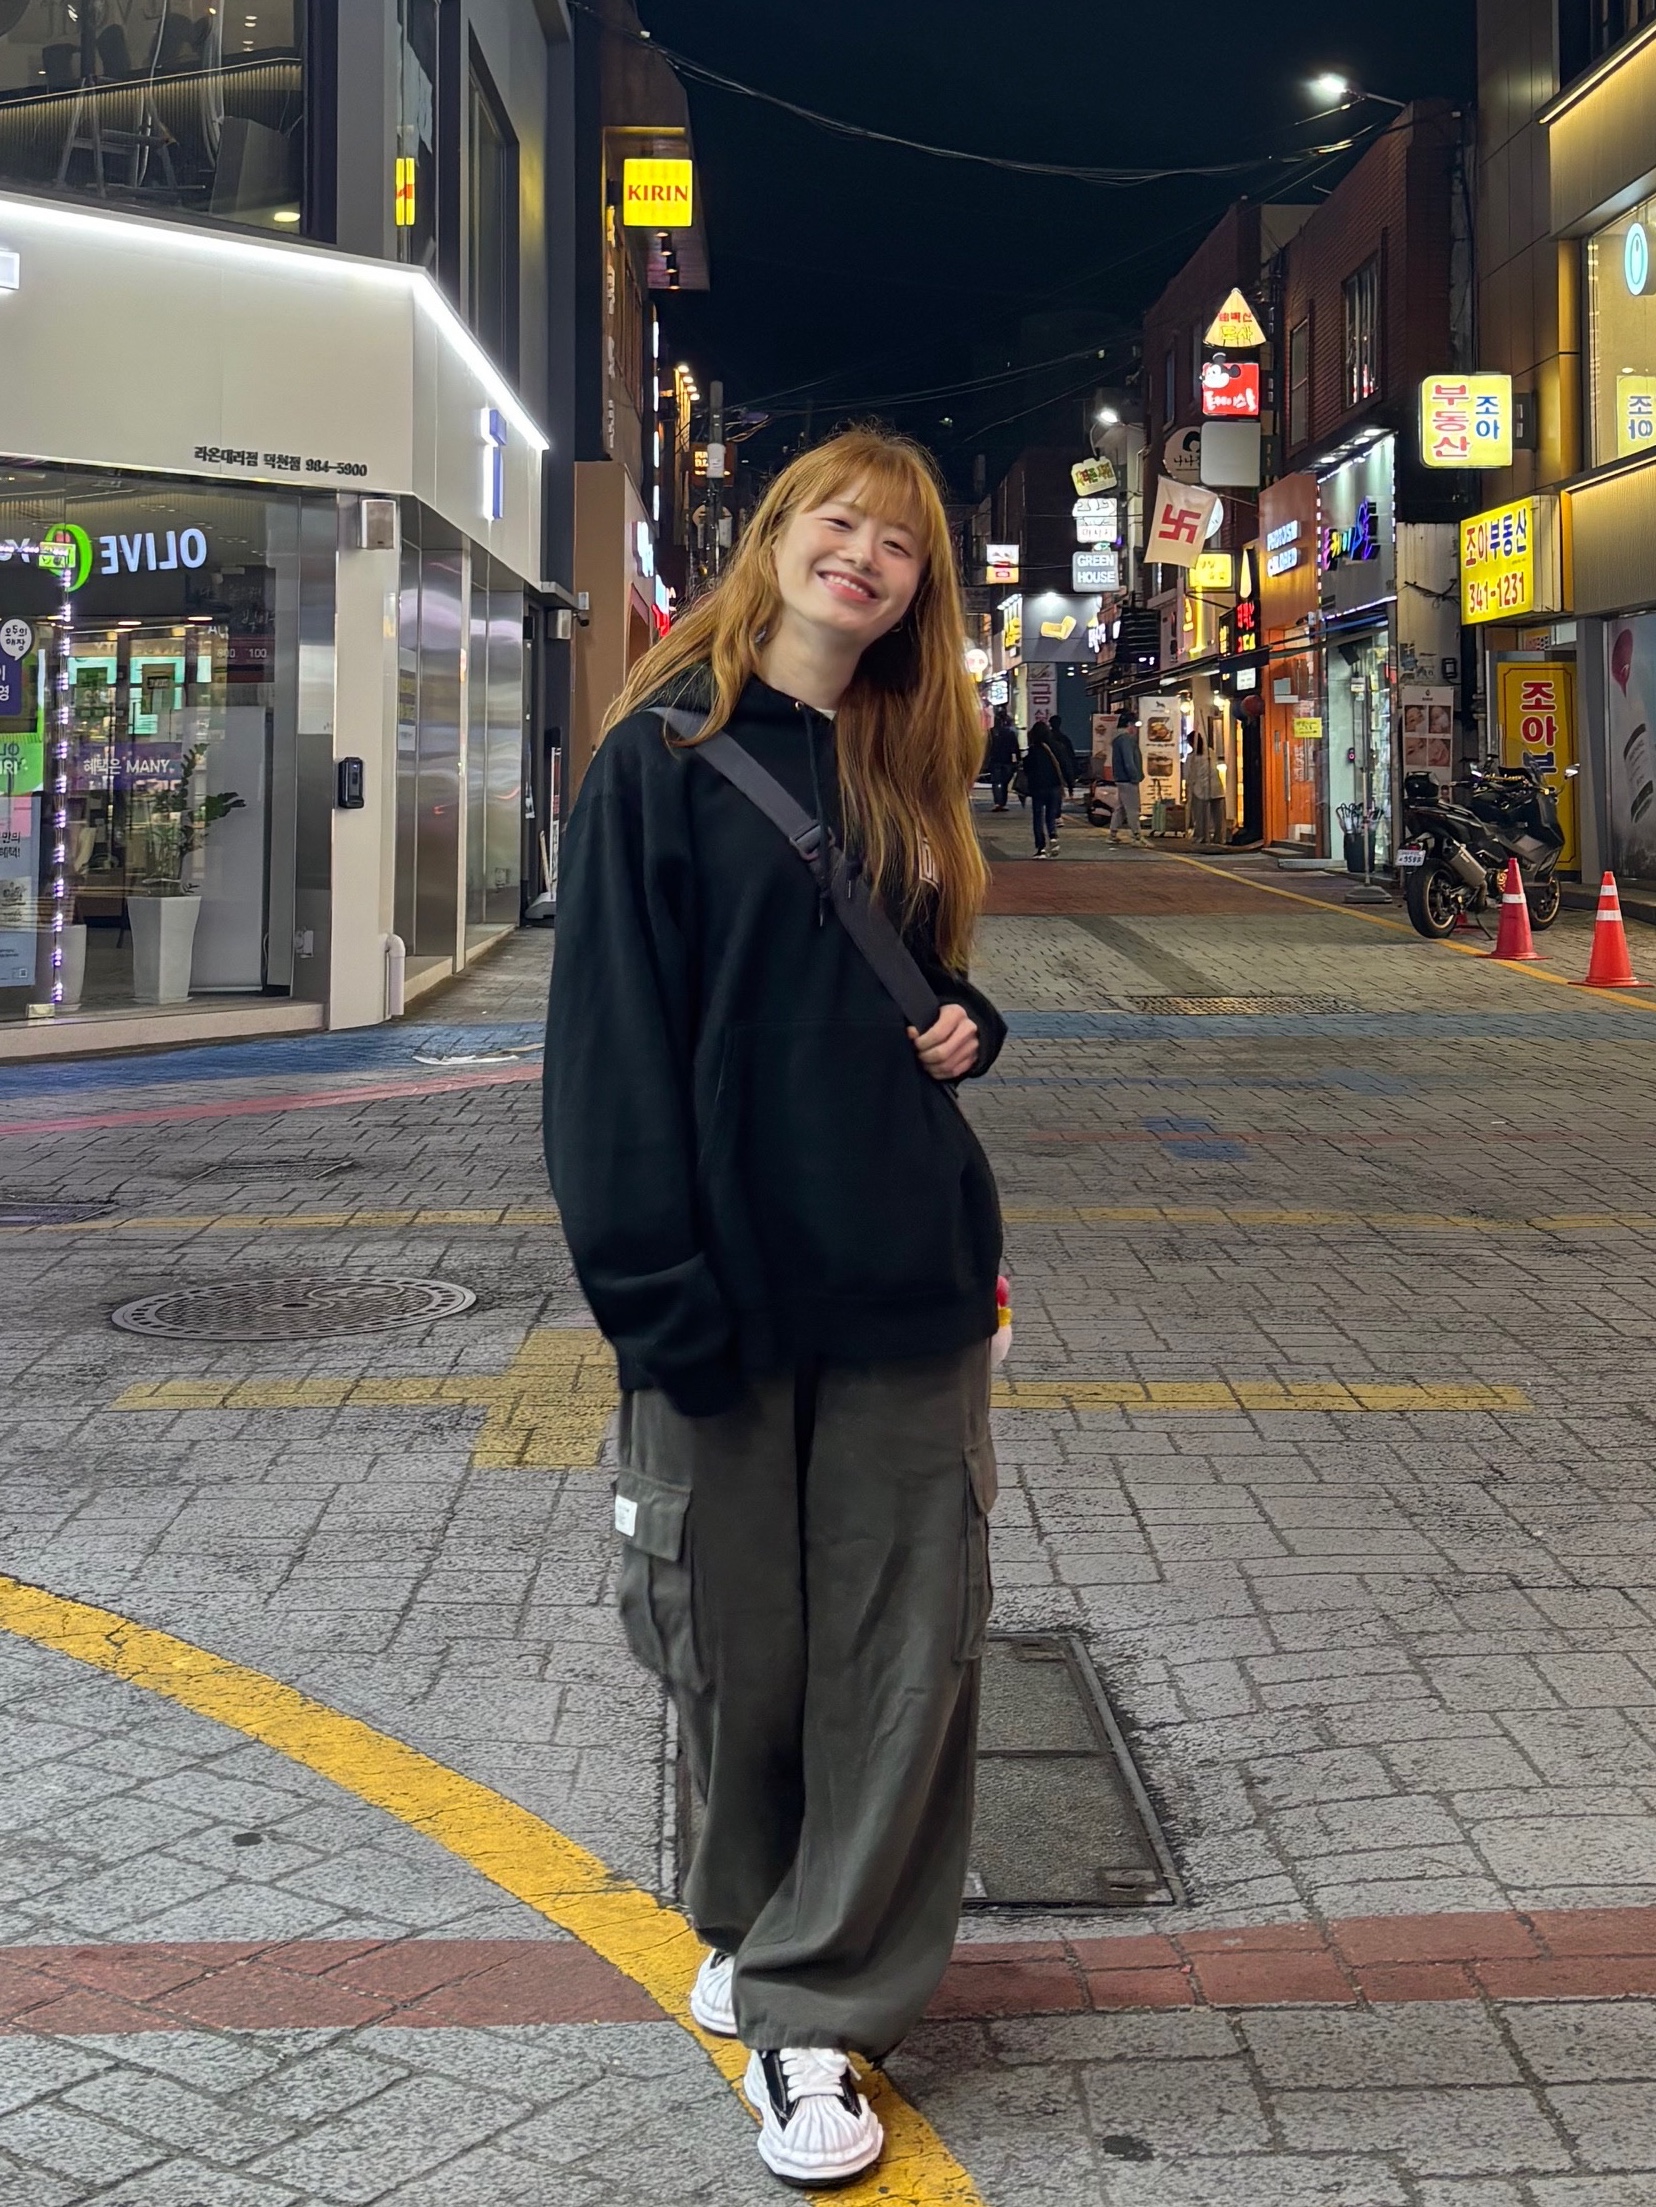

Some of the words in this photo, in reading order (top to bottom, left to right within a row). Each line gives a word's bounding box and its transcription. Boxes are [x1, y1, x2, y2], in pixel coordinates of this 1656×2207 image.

[628, 185, 688, 201] KIRIN
[1432, 384, 1470, 457] 부동산
[1475, 396, 1500, 440] 조아
[1466, 508, 1527, 567] 조아부동산
[1077, 554, 1115, 567] GREEN
[1077, 570, 1116, 584] HOUSE
[1469, 571, 1524, 614] 341-1231
